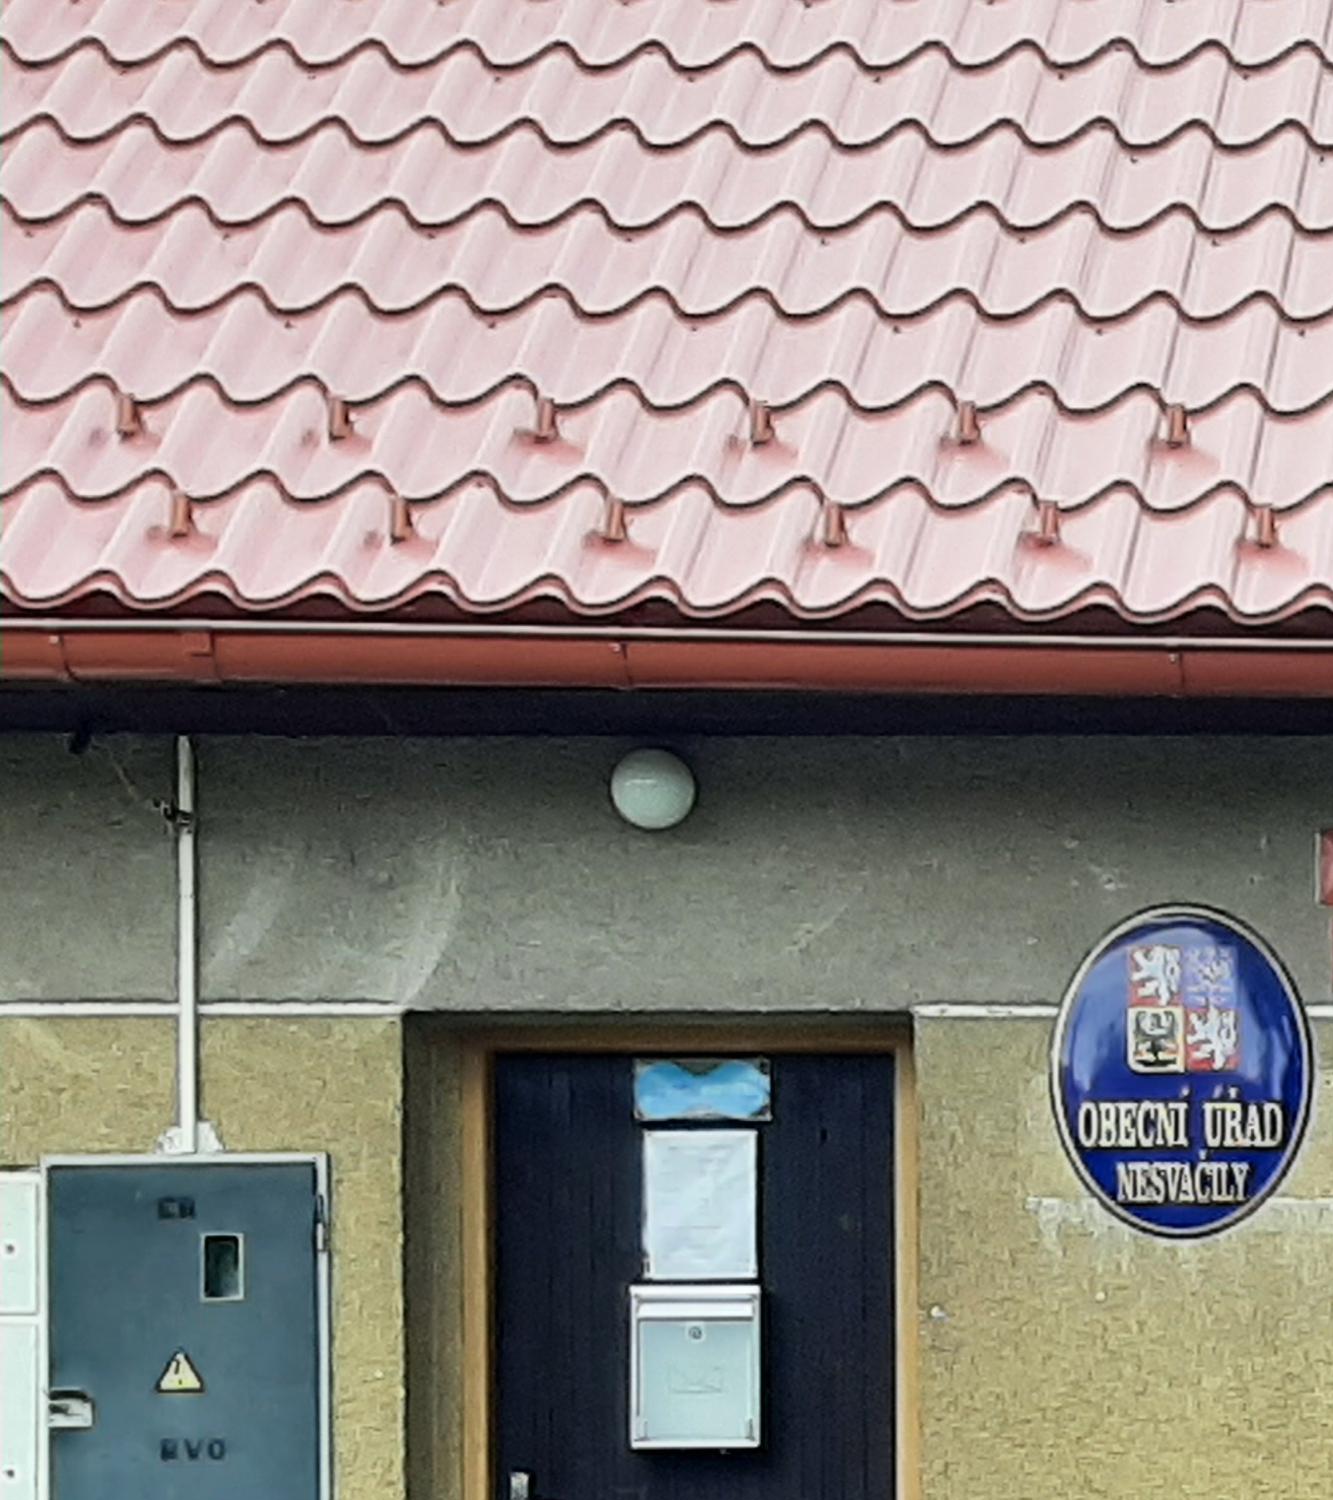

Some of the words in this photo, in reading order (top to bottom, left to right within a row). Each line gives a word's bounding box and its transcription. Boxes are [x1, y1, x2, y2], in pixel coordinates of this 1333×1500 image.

[1077, 1085, 1189, 1148] OBECNÍ
[1202, 1085, 1284, 1148] ÚŘAD
[1115, 1150, 1250, 1204] NESVAČILY
